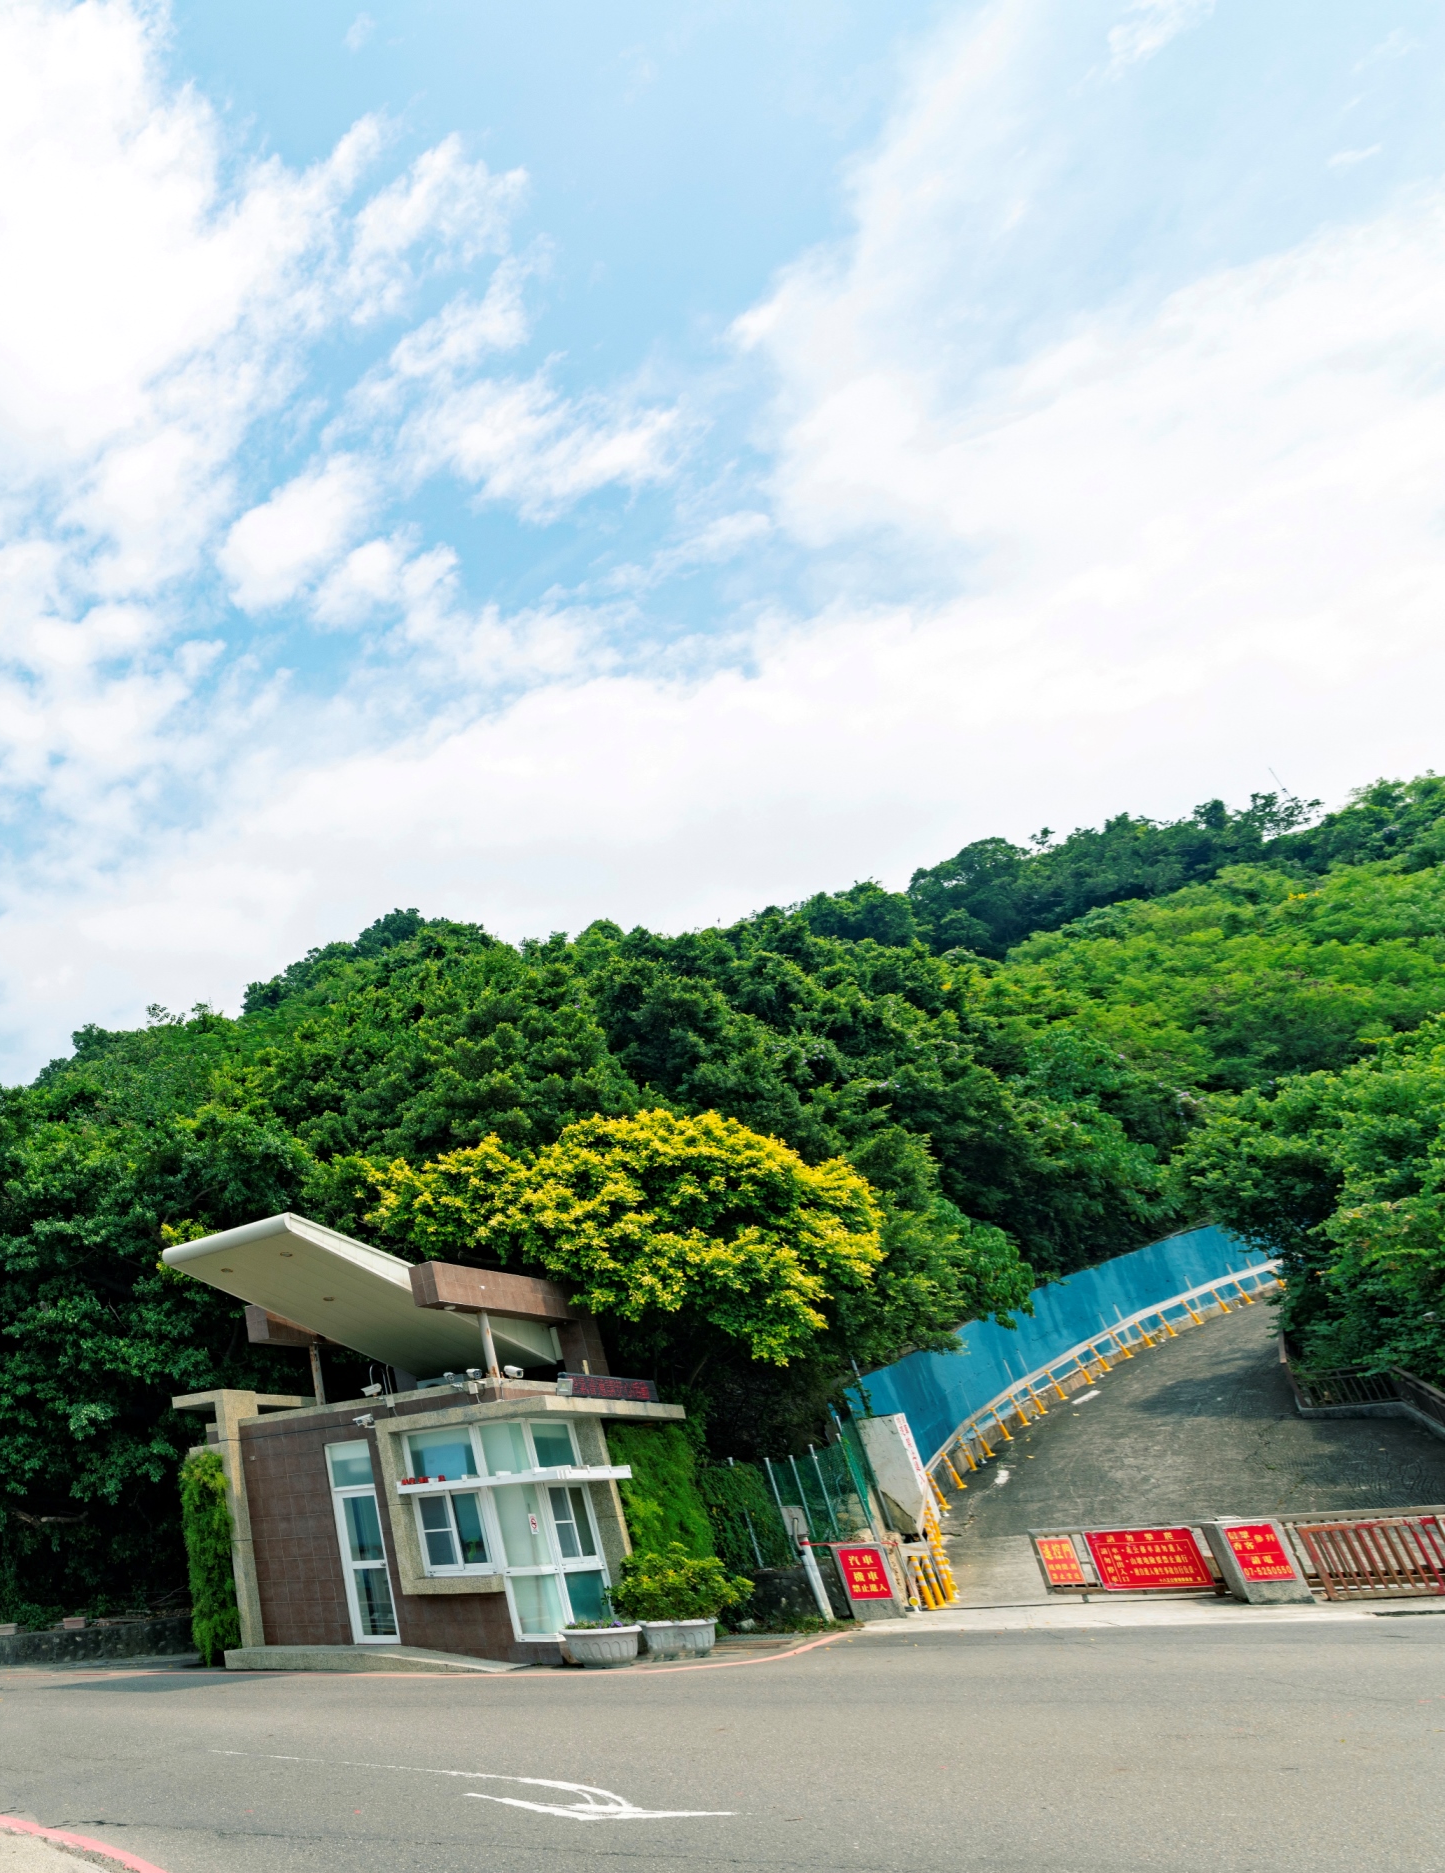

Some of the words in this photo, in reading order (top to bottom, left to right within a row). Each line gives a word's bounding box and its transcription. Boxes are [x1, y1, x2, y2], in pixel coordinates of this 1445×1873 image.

[848, 1555, 874, 1566] 汽車
[1100, 1547, 1118, 1583] 請勿停車
[1111, 1547, 1130, 1582] 車輛出入口
[853, 1571, 879, 1582] 機車
[852, 1583, 888, 1593] 禁止進入
